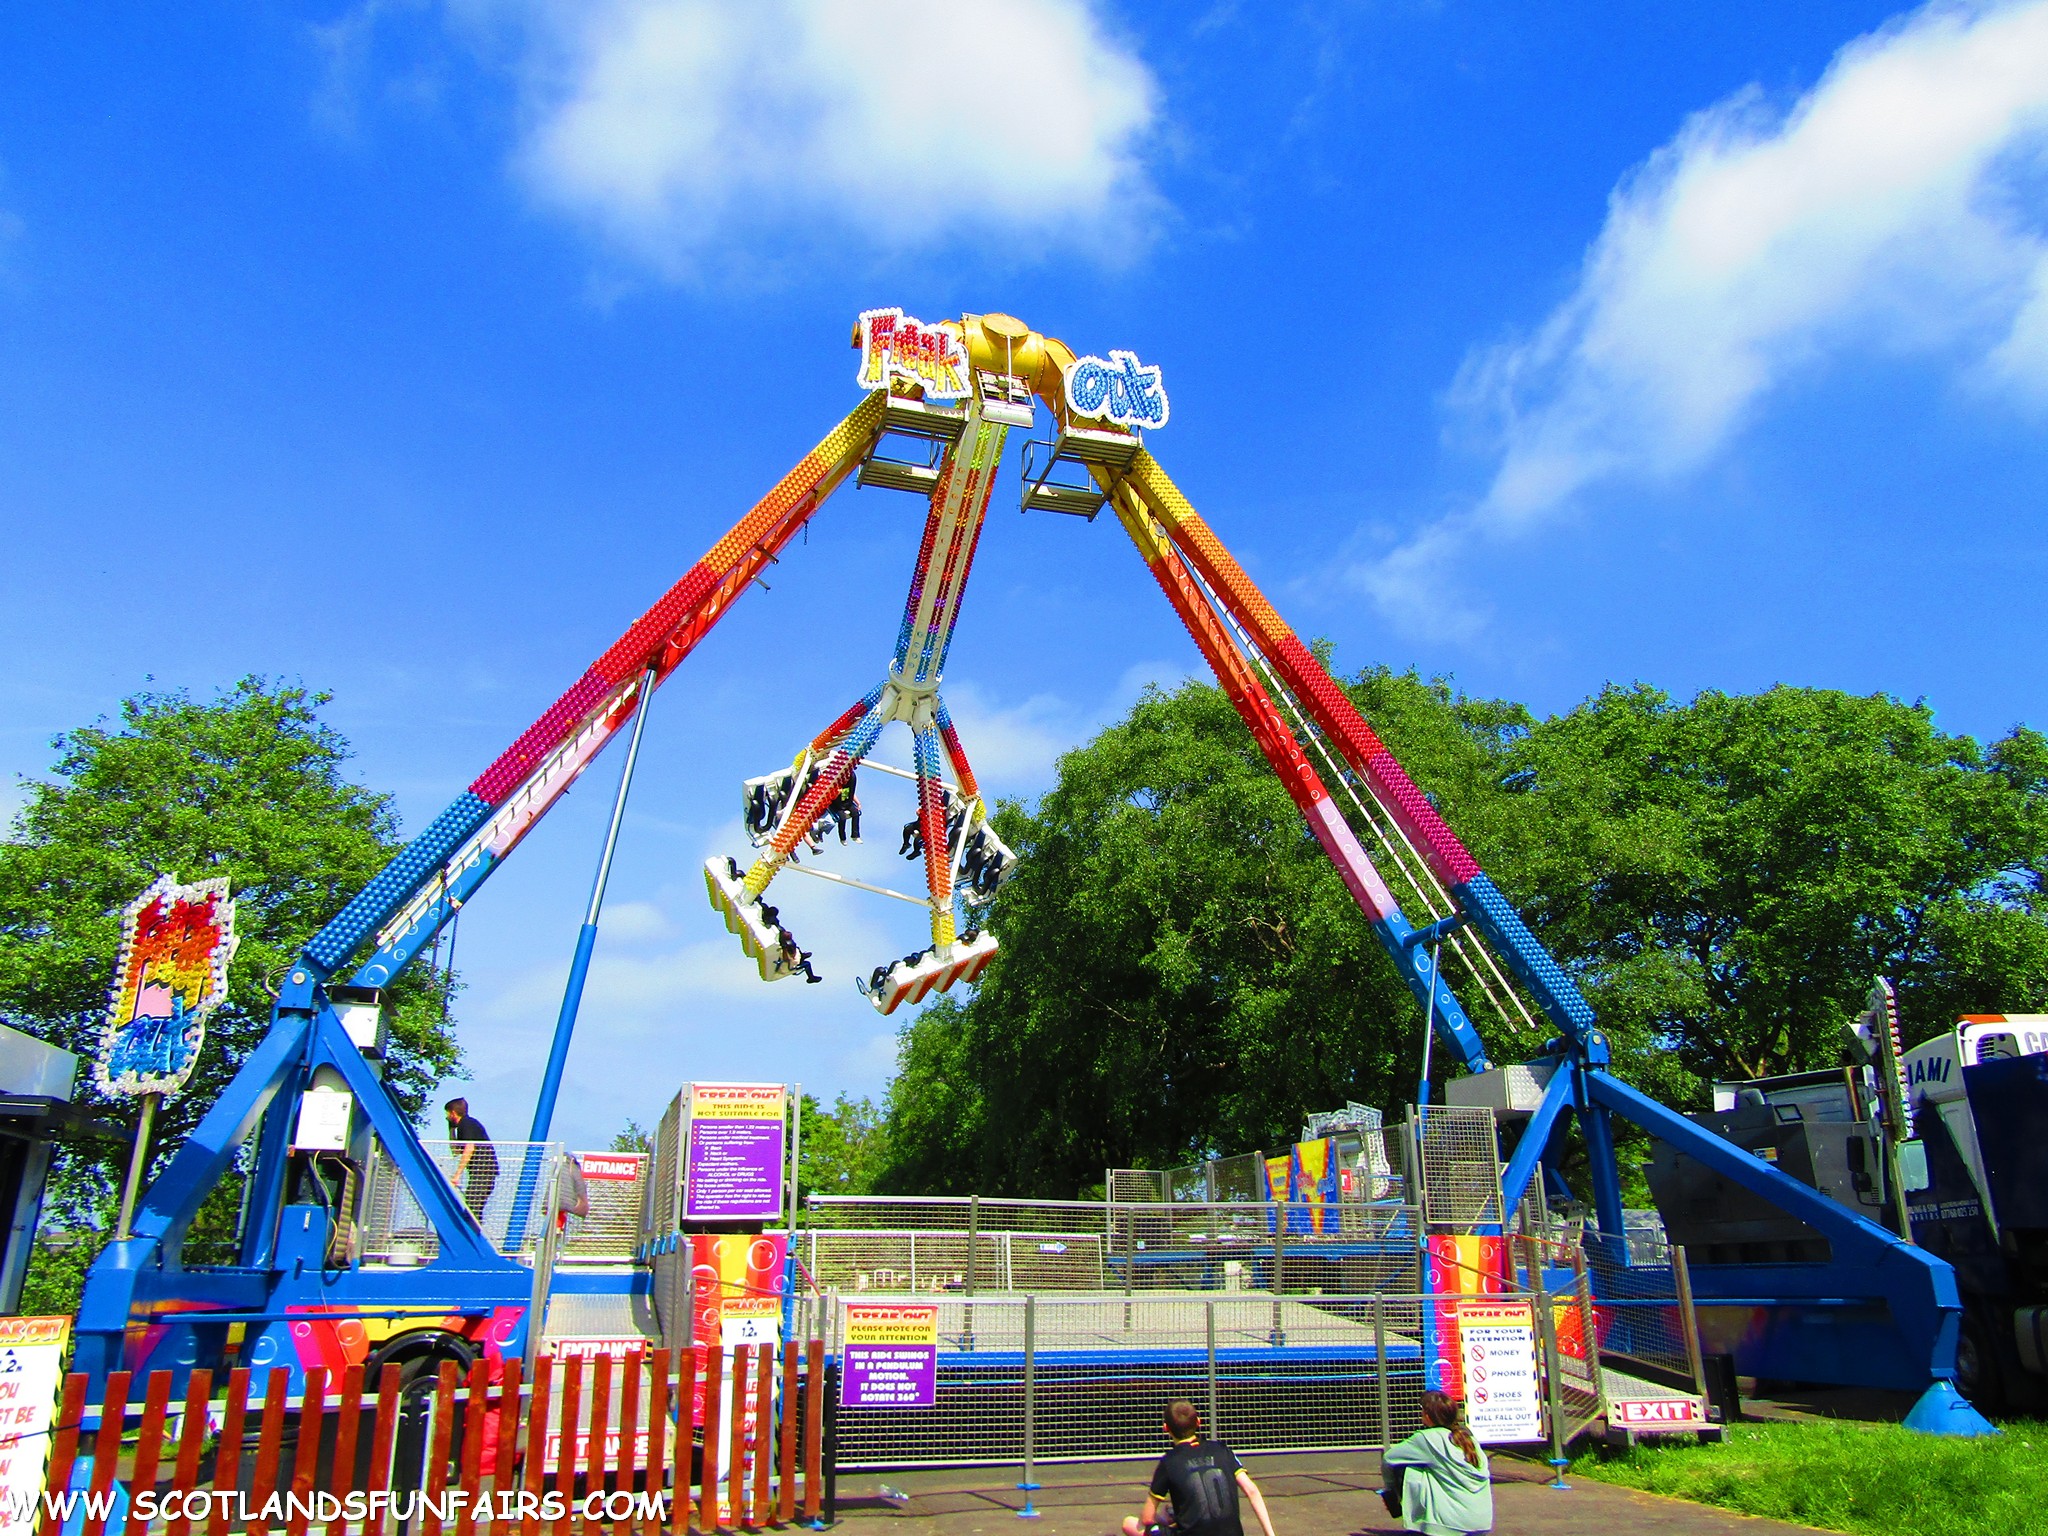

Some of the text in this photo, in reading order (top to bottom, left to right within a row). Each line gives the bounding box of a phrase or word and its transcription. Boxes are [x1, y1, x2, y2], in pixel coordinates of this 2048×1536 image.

[1907, 1057, 1951, 1086] IAMI
[698, 1089, 780, 1101] FREAK OUT
[583, 1160, 636, 1175] ENTRANCE
[852, 1308, 932, 1322] FREAK OUT
[26, 1318, 64, 1342] OUT
[561, 1341, 642, 1359] ENTRANCE
[850, 1351, 930, 1359] THIS RIDE SWINGS
[854, 1362, 925, 1370] IN A PENDULUM
[868, 1372, 909, 1380] MOTION.
[0, 1382, 20, 1400] OU
[860, 1382, 917, 1391] IT DOES NOT
[860, 1393, 896, 1402] ROTATE
[15, 1406, 36, 1424] BE
[1626, 1403, 1686, 1420] EXIT
[1190, 1468, 1230, 1520] 10
